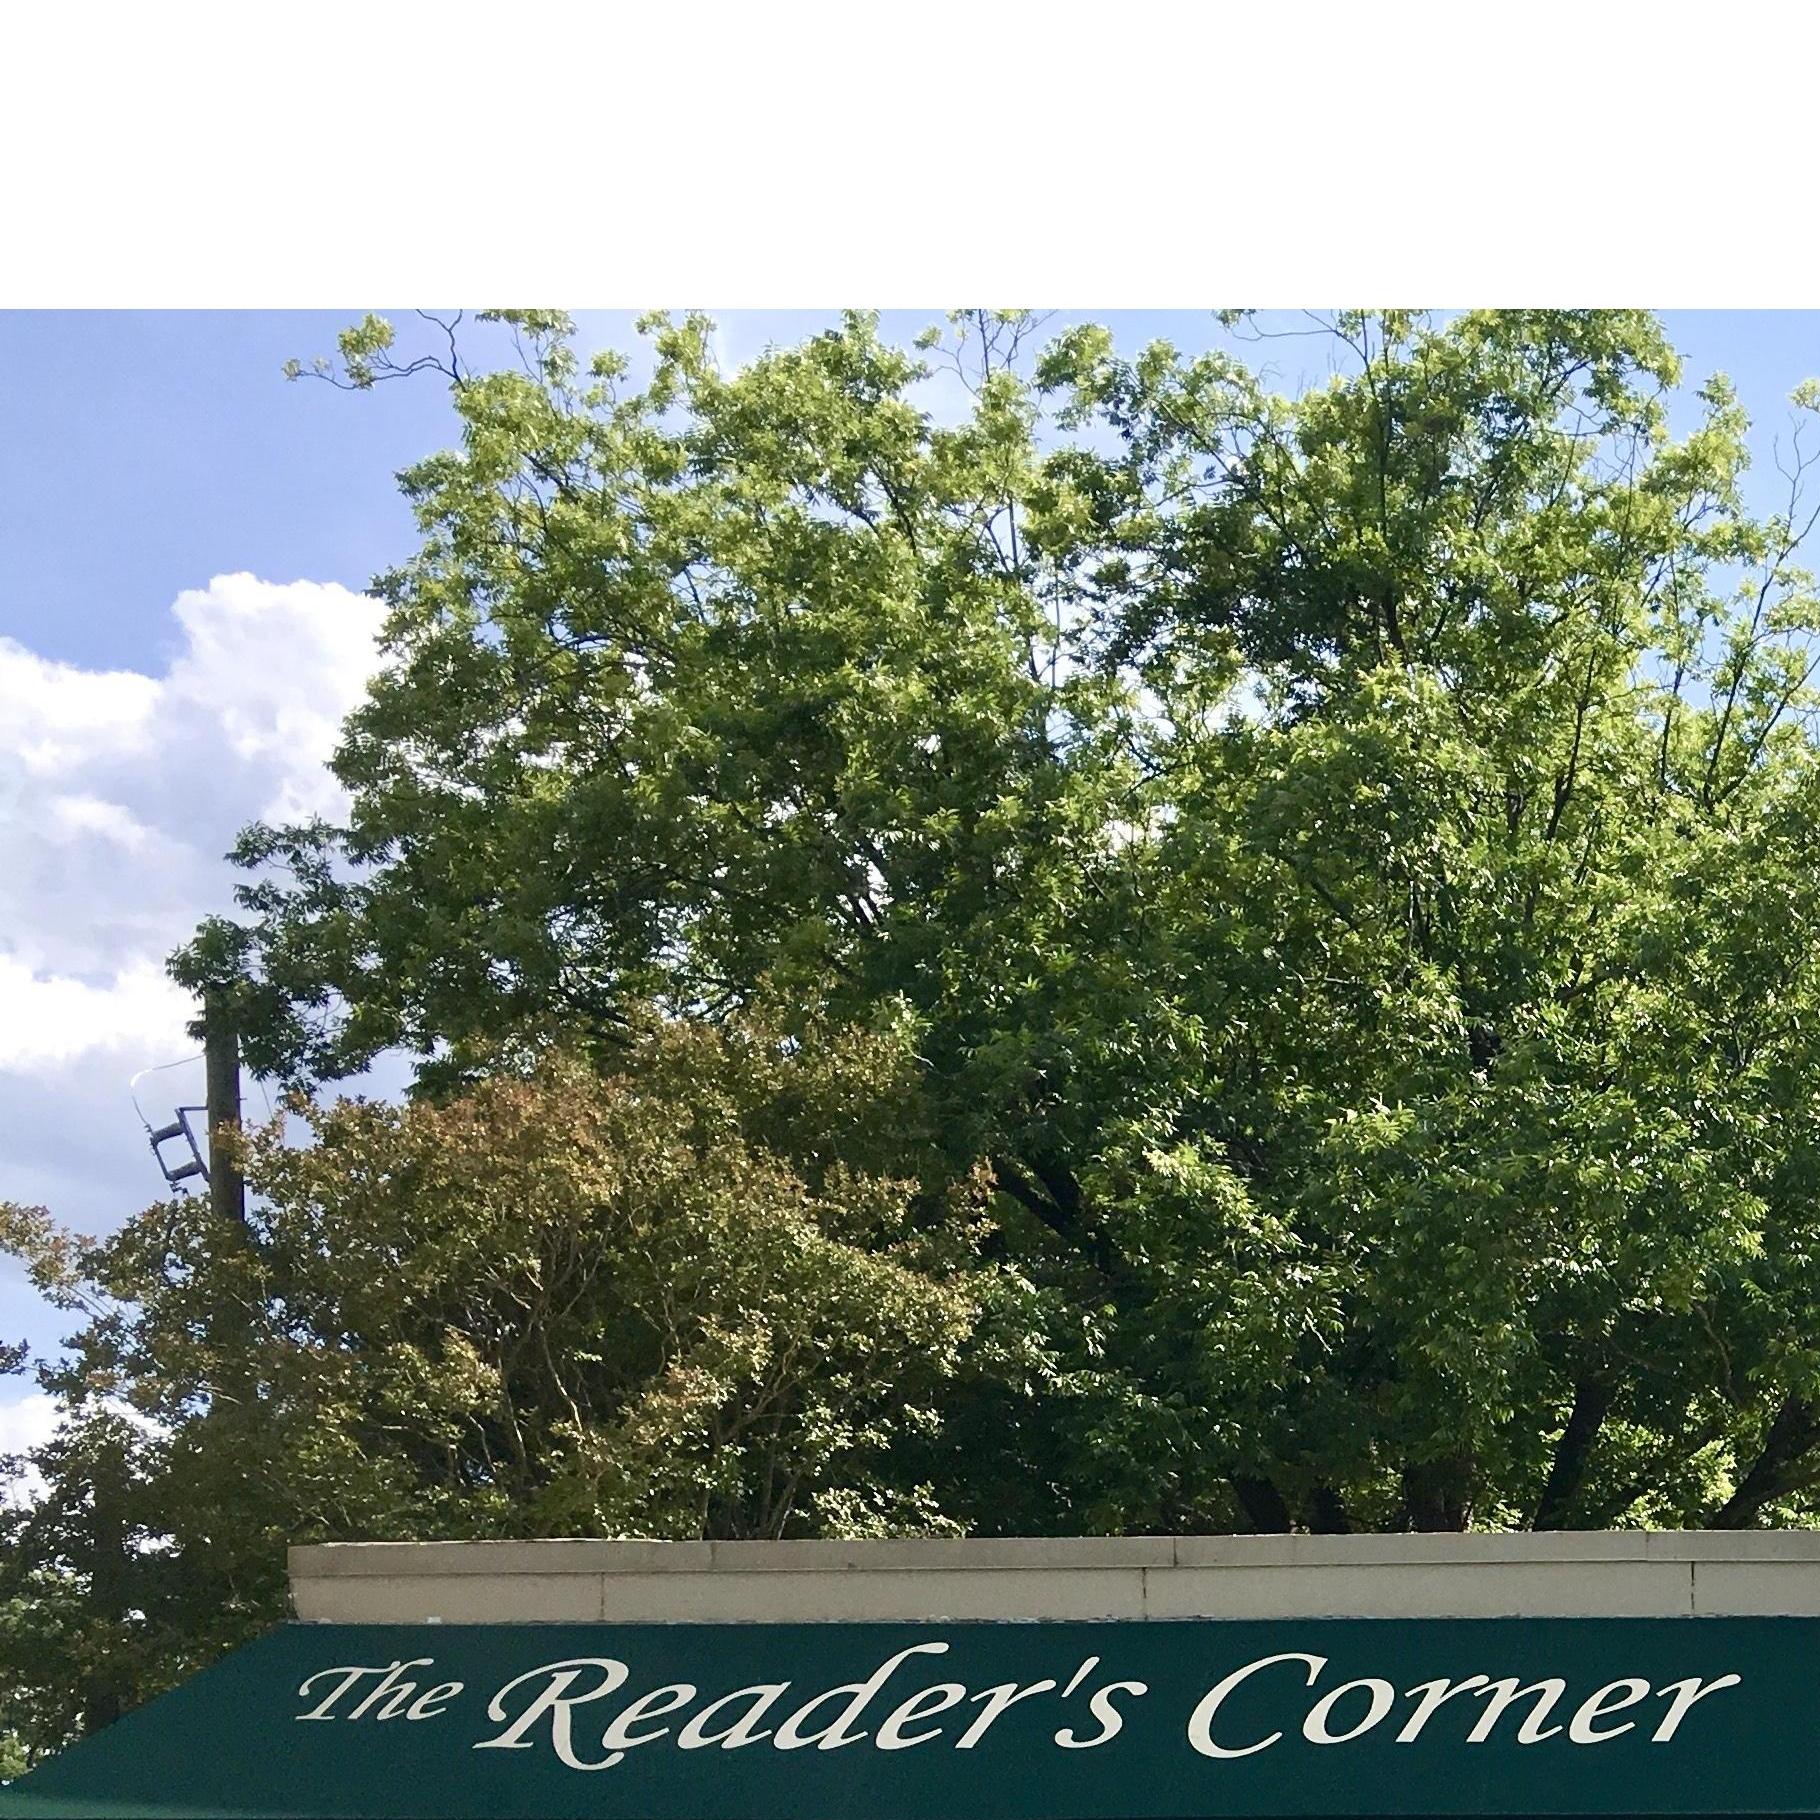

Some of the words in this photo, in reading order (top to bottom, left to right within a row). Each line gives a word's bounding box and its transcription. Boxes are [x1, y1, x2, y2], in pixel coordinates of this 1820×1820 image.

[295, 1658, 464, 1721] The
[472, 1642, 1148, 1771] Reader's
[1187, 1653, 1741, 1759] Corner
